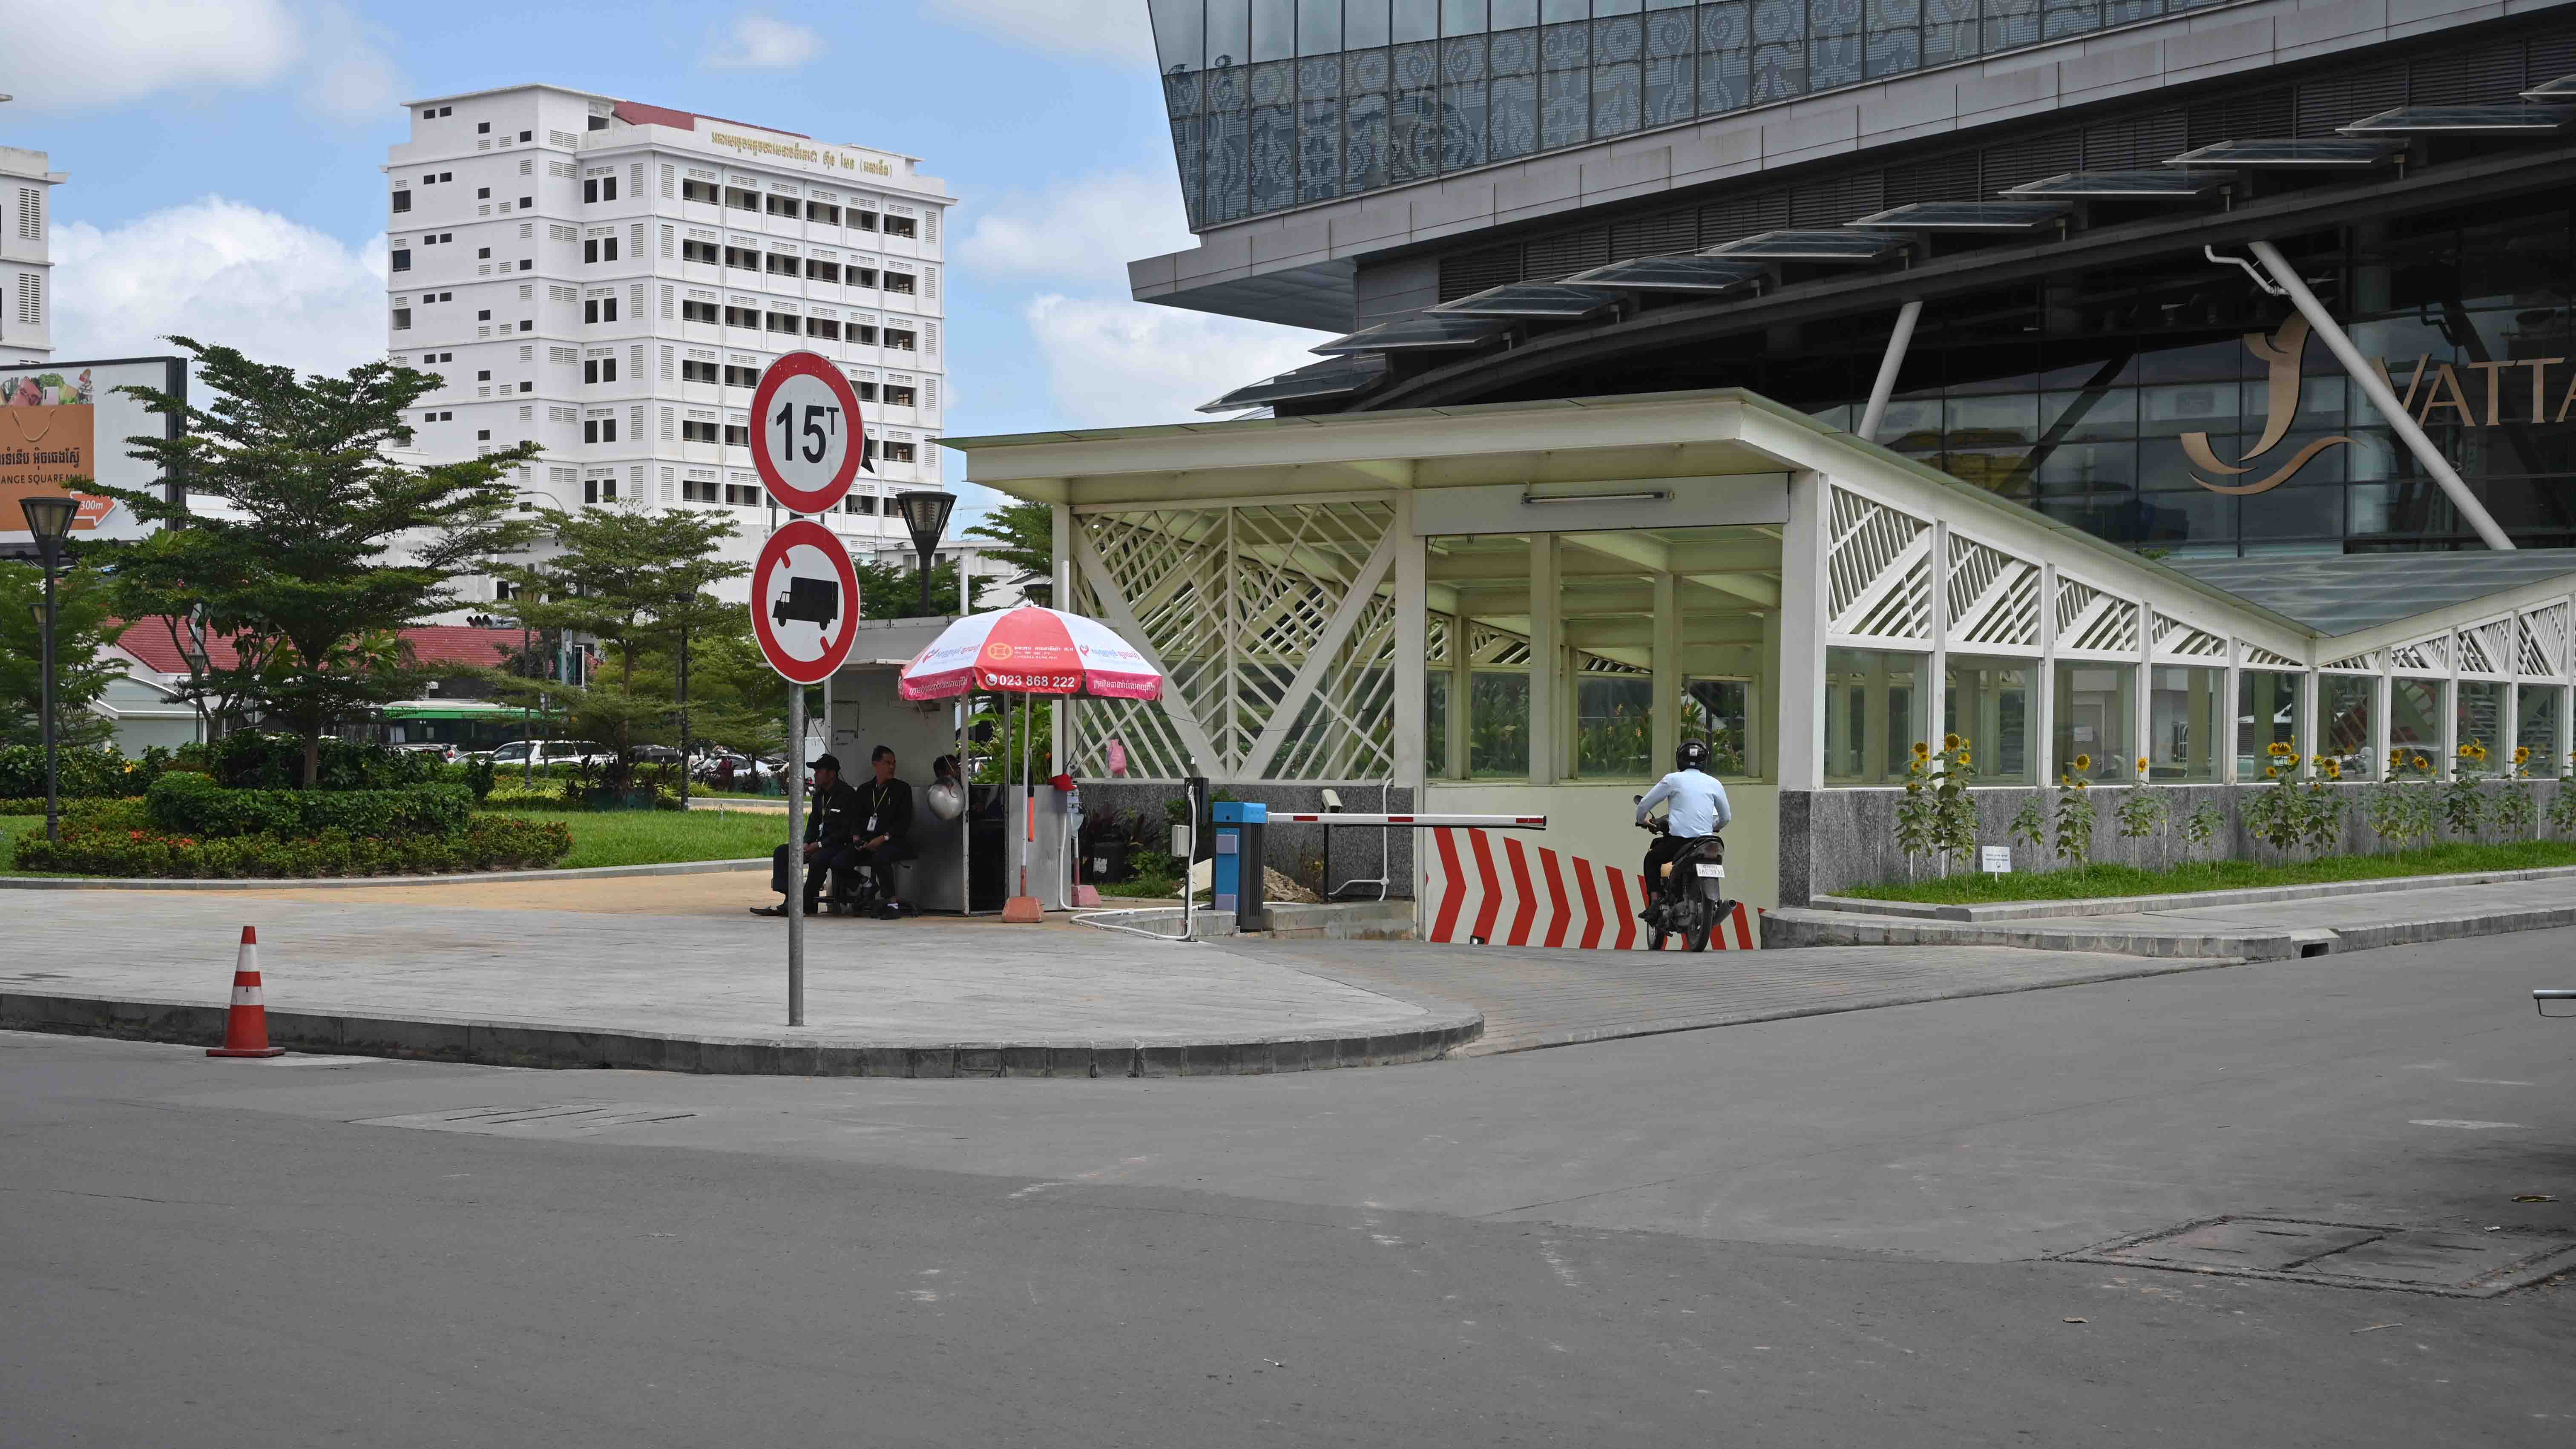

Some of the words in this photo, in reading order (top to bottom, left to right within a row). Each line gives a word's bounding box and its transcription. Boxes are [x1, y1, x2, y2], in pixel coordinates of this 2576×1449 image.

[0, 475, 25, 484] ANGE
[27, 474, 63, 485] SQUARE
[80, 500, 103, 510] 300m
[999, 675, 1022, 686] 023
[1026, 676, 1049, 686] 868
[1052, 676, 1075, 687] 222
